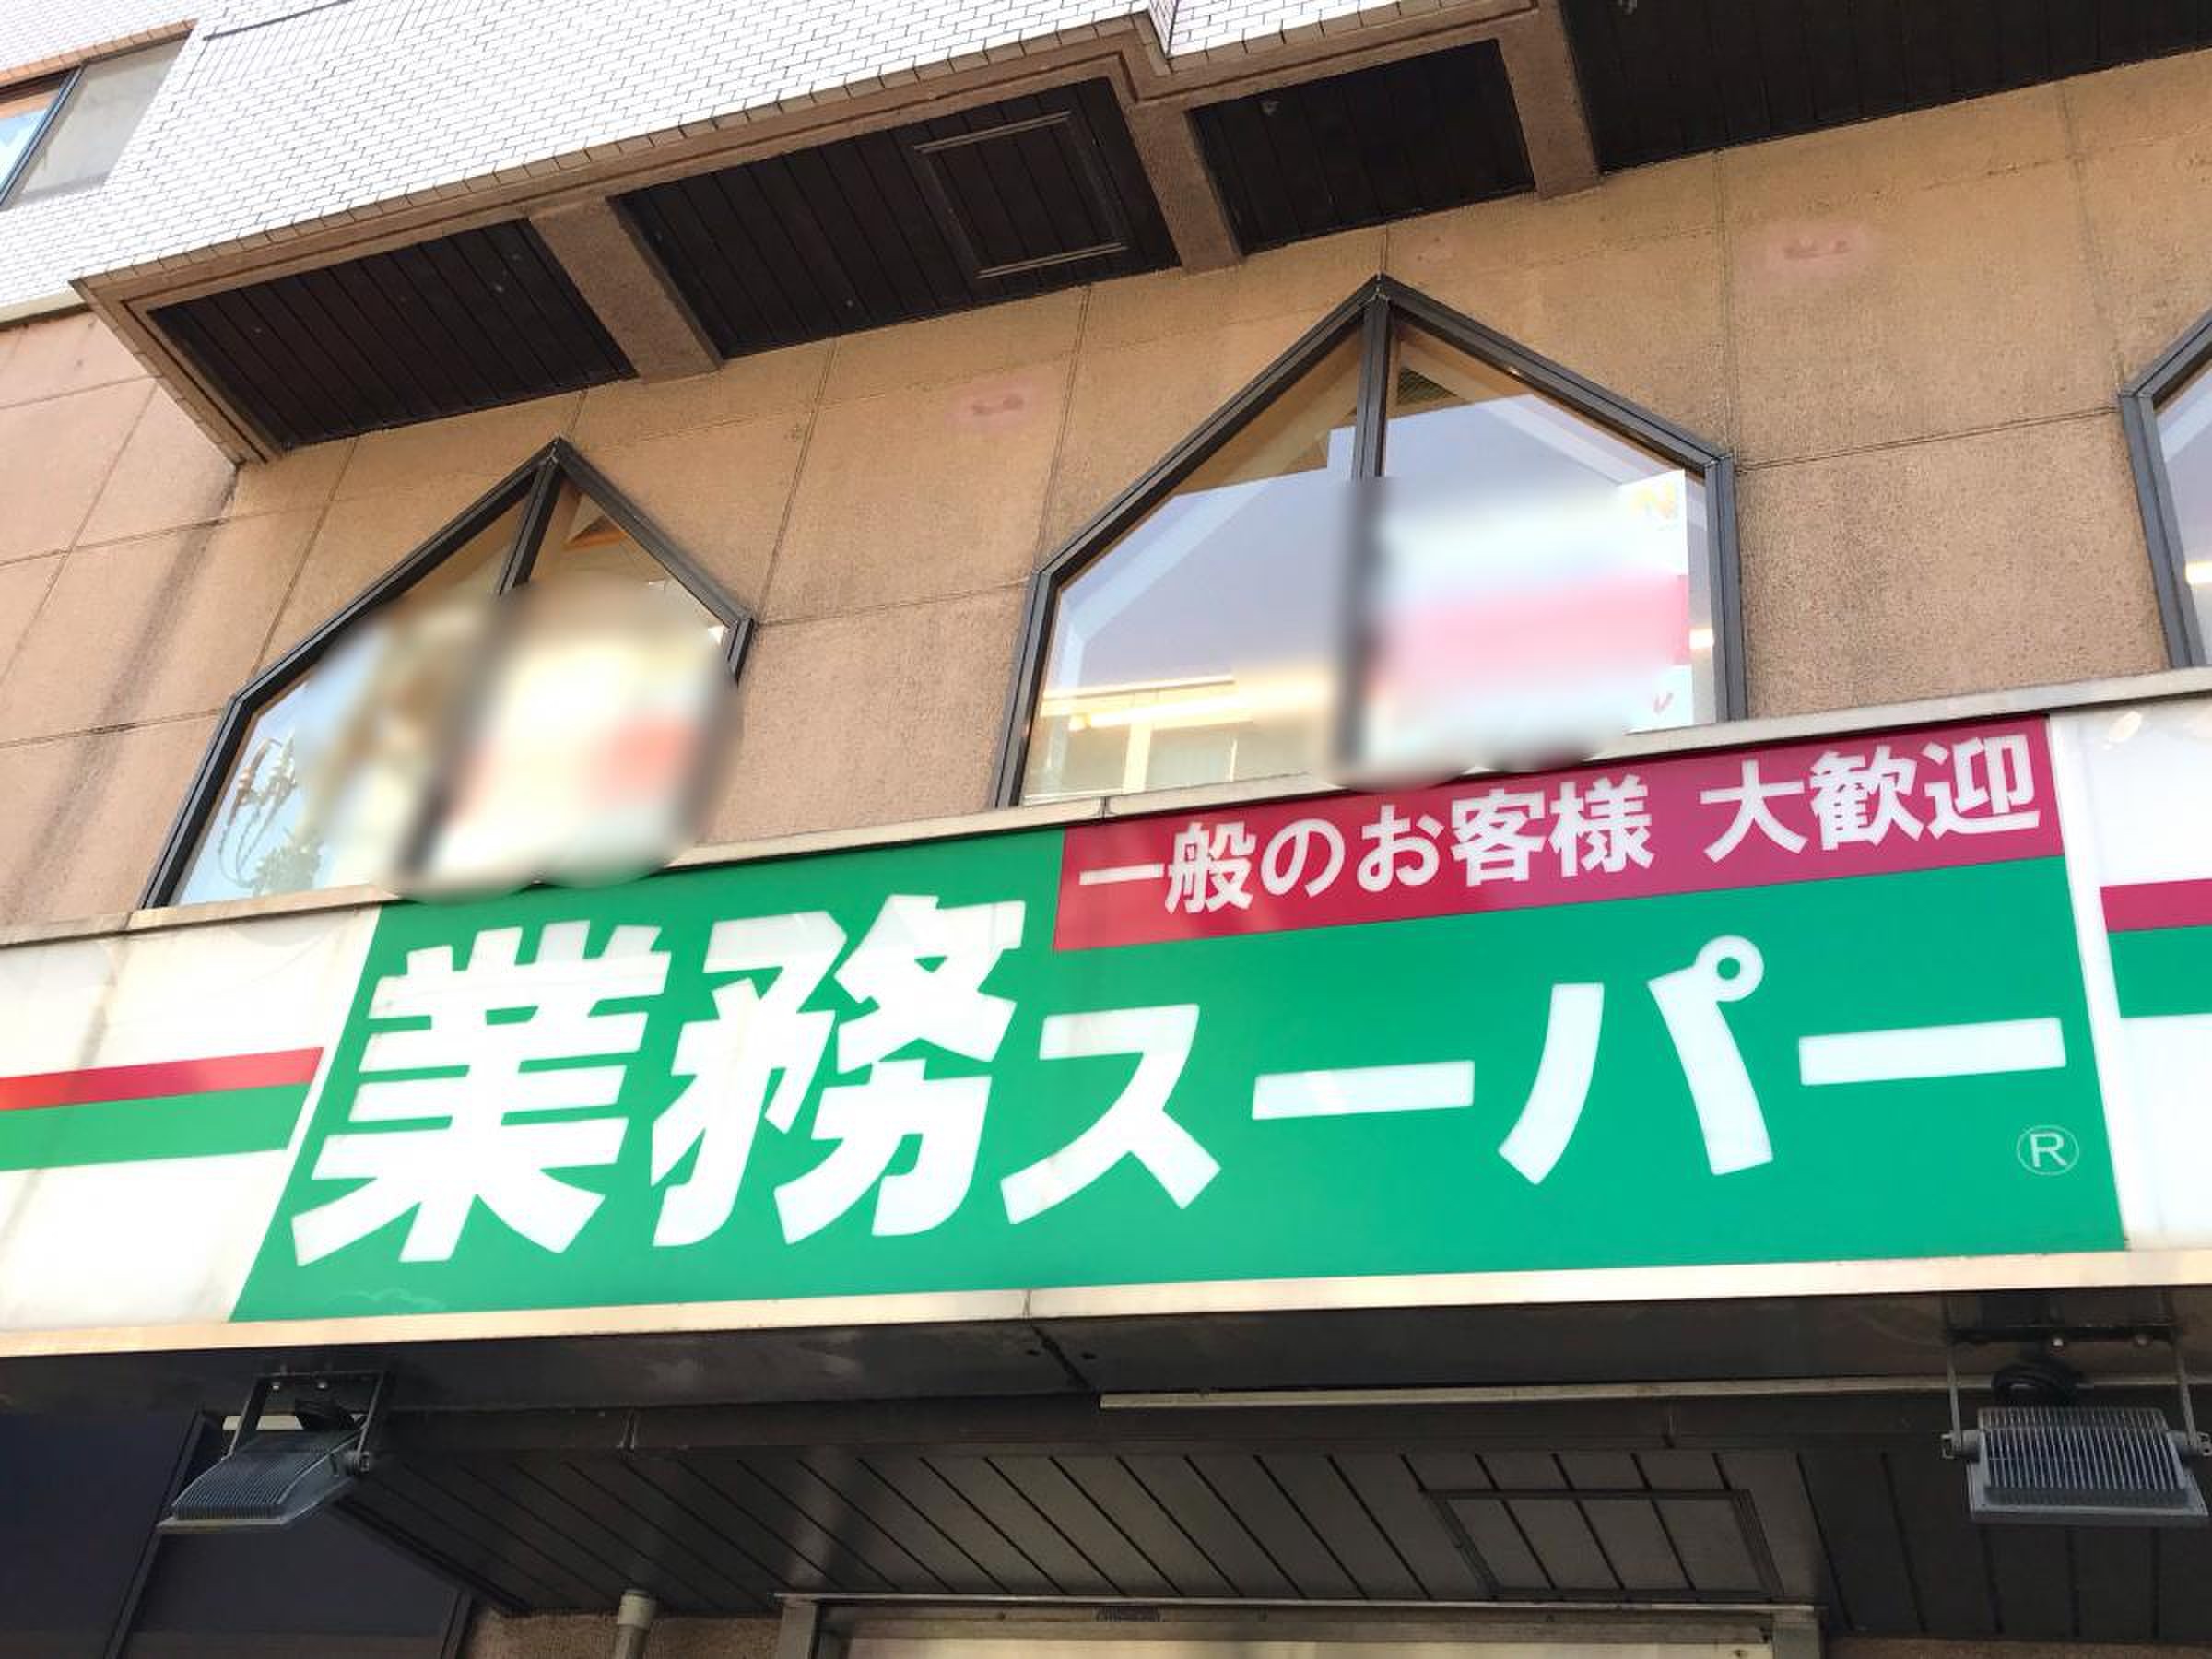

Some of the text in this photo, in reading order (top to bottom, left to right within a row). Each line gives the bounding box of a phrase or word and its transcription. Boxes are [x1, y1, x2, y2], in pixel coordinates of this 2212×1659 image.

[1077, 734, 2041, 915] 一般のお客様 大歓迎
[290, 893, 2067, 1267] 業務スーパー
